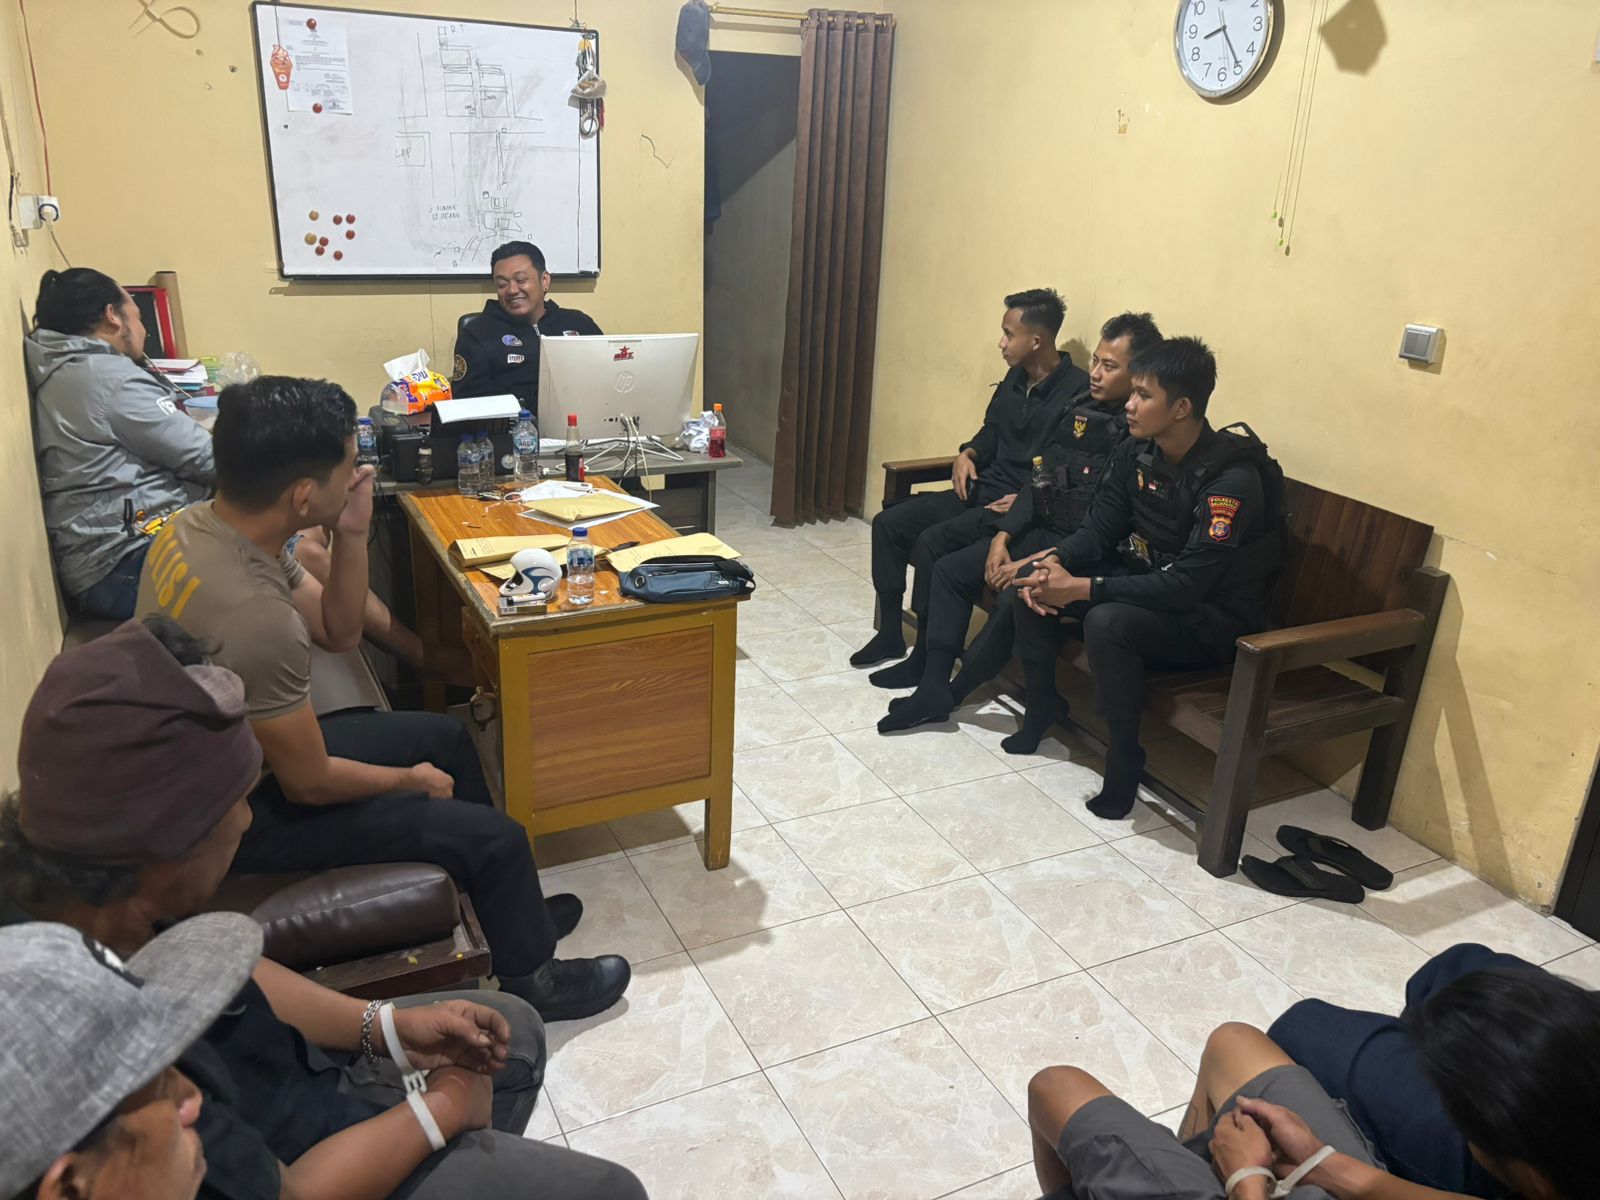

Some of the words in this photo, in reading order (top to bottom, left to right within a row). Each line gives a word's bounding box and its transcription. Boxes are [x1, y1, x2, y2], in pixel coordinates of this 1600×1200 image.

[1193, 1, 1206, 16] 10
[1253, 16, 1263, 31] 3
[1188, 24, 1198, 39] 9
[1191, 47, 1201, 61] 8
[1246, 41, 1256, 56] 4
[1203, 62, 1212, 78] 7
[1217, 67, 1227, 82] 6
[1232, 60, 1243, 75] 5
